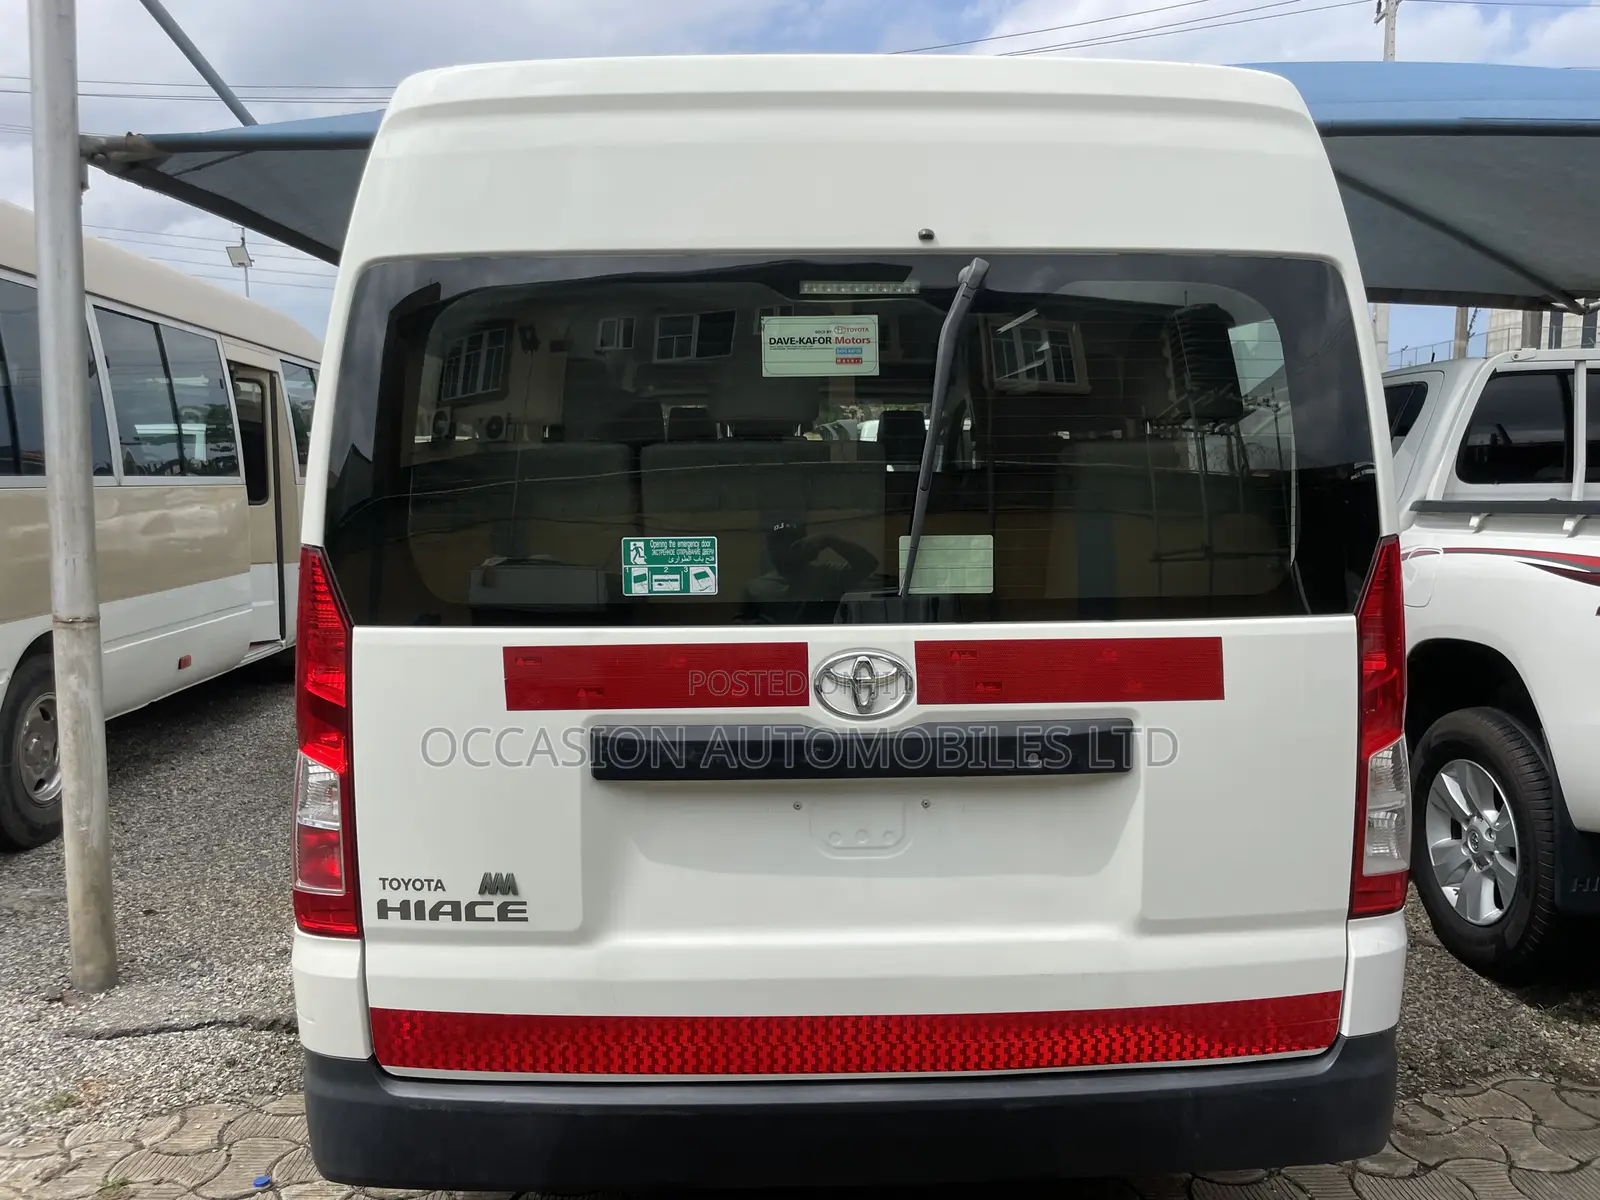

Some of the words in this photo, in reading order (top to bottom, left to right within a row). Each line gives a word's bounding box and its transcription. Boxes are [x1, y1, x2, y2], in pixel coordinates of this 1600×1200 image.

[769, 336, 832, 345] DAVE-KAFOR
[834, 336, 871, 345] Motors
[650, 540, 667, 550] Opening
[668, 540, 676, 548] the
[677, 541, 700, 550] emergency
[701, 540, 711, 548] door
[378, 877, 447, 892] TOYOTA
[376, 898, 529, 922] HIACE
